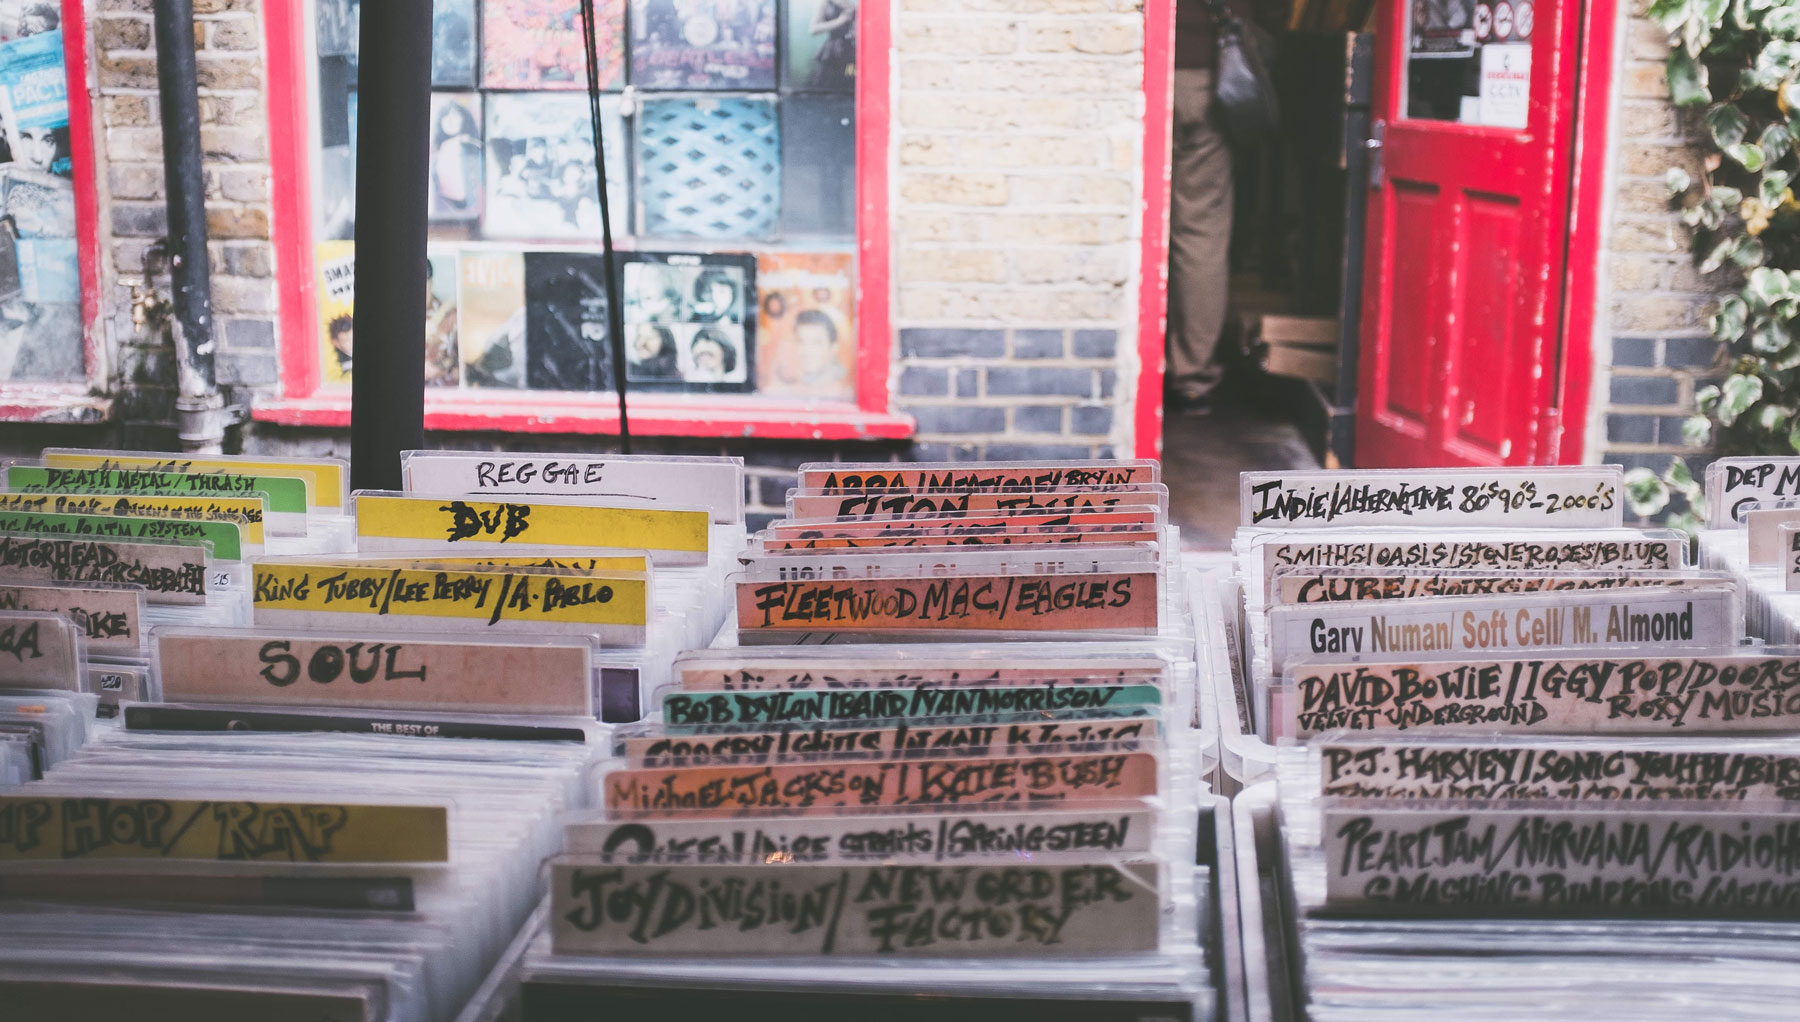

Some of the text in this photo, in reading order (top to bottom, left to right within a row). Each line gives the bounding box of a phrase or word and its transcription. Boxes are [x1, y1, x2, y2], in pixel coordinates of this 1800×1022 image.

[45, 468, 110, 489] DEATH
[117, 466, 171, 489] METAL
[185, 472, 256, 491] THRASH
[475, 462, 605, 487] REGGAE
[1725, 463, 1775, 492] DEP
[439, 500, 531, 543] DUB
[755, 583, 917, 628] FLEETWOOD
[1462, 609, 1508, 649] Soft
[1573, 606, 1598, 644] M.
[1606, 601, 1693, 643] Almond
[259, 640, 427, 687] SOUL
[665, 694, 735, 725] BOB
[1298, 667, 1395, 714] DAVID
[1606, 689, 1701, 727] ROXY
[371, 722, 440, 735] THE BEST OF
[1297, 700, 1548, 732] VELVET UNDERGROUND
[918, 760, 1020, 801] KATE
[1023, 755, 1128, 789] BUSH
[855, 864, 978, 904] NEW
[975, 864, 1134, 906] ORDER
[866, 903, 1081, 954] FACTORY
